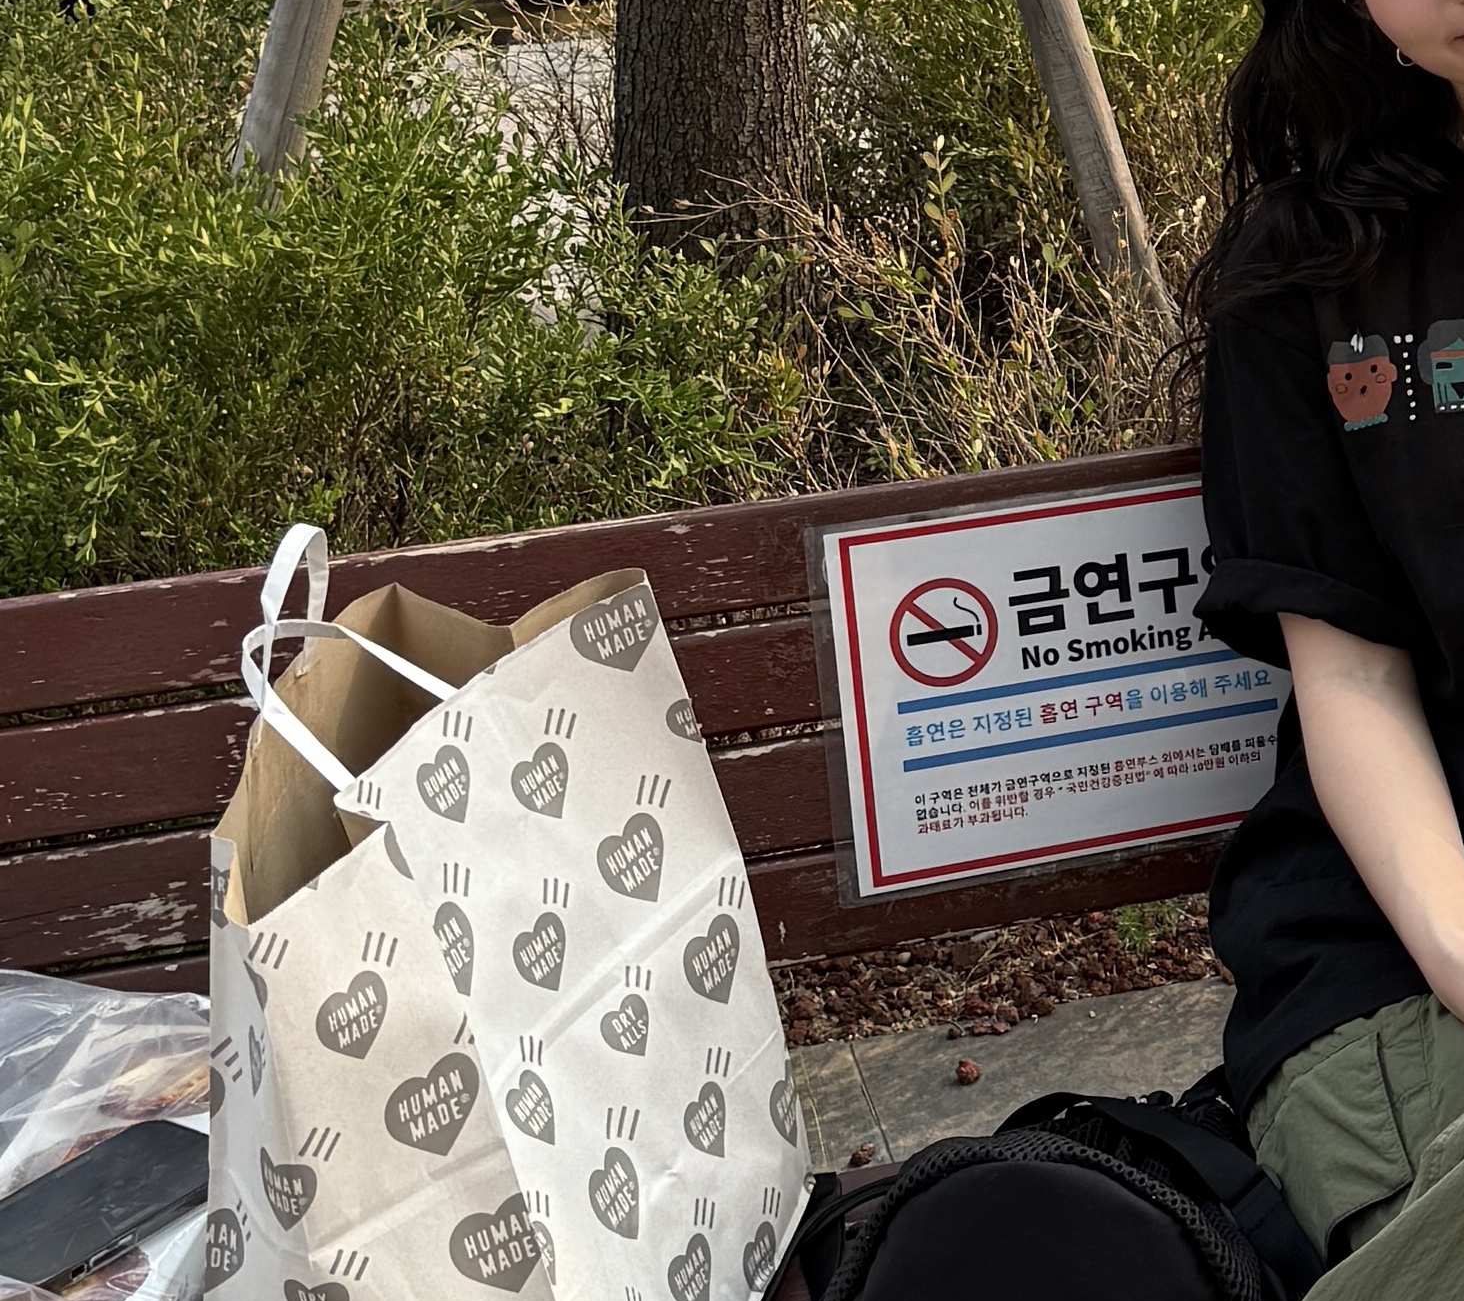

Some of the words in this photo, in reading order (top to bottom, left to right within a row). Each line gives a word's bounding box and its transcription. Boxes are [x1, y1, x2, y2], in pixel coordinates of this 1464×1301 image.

[583, 598, 648, 643] HUMAN
[1021, 645, 1060, 670] No
[1067, 624, 1193, 662] Smoking
[906, 717, 967, 747] 흡연은
[973, 705, 1033, 735] 지정된
[1039, 699, 1079, 725] 흡연
[1085, 688, 1144, 717] 구역을
[1150, 677, 1208, 705] 이용해
[1213, 669, 1272, 695] 주세요
[423, 758, 461, 797] HUMAN
[520, 754, 559, 796] HUMAN
[915, 793, 926, 806] 이
[929, 787, 964, 805] 구역은
[968, 780, 1002, 798] 전체가
[1005, 768, 1074, 792] 금연구역으로
[1077, 762, 1111, 778] 지정된
[1114, 754, 1158, 773] 흡연부스
[1161, 746, 1207, 764] 외에서는
[916, 802, 967, 822] 없습니다.
[969, 796, 992, 812] 이를
[996, 791, 1030, 808] 위반할
[1033, 785, 1056, 801] 경우
[1167, 762, 1189, 777] 따라
[1192, 756, 1226, 773] 10만원
[1229, 749, 1262, 766] 이하의
[917, 816, 964, 835] 과태료가
[968, 806, 1029, 827] 부과됩니다.
[606, 826, 655, 877] HUMAN
[439, 916, 463, 951] MAN
[520, 925, 559, 968] HUMAN
[692, 928, 733, 978] HUMAN
[328, 985, 378, 1034] HUMAN
[611, 1005, 636, 1034] DRY
[620, 1019, 647, 1051] ALLS
[399, 1068, 465, 1123] HUMAN
[594, 1161, 629, 1212] HUMAN
[478, 1235, 536, 1279] MADE
